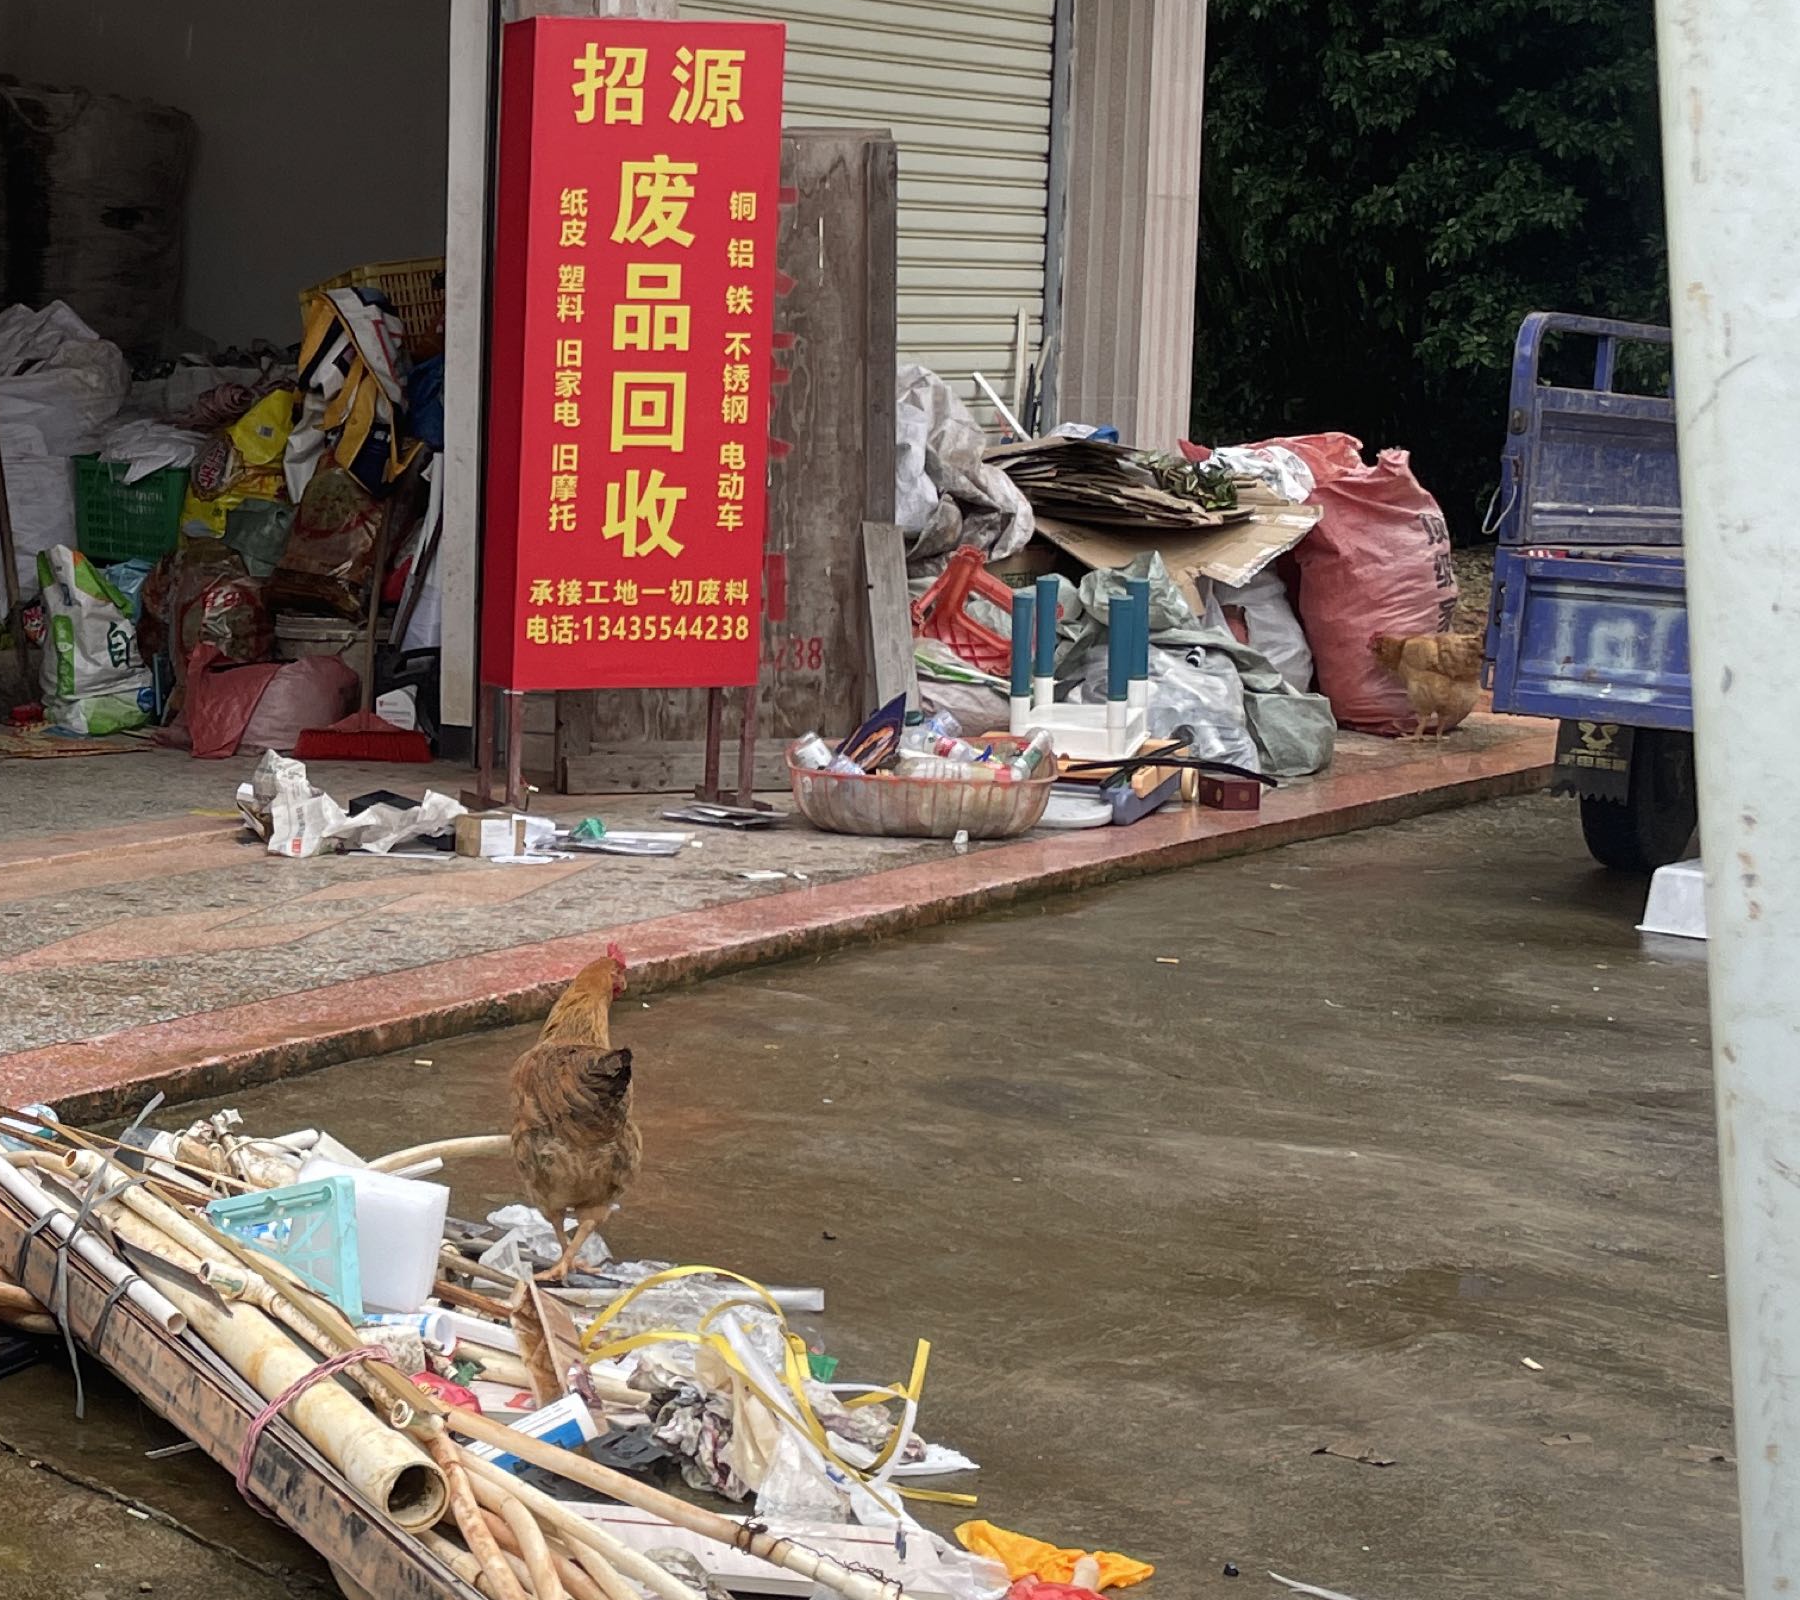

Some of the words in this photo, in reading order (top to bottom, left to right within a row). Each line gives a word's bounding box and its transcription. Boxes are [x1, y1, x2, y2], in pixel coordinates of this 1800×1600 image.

[572, 43, 746, 129] 招源
[559, 188, 589, 248] 纸皮
[729, 191, 757, 221] 铜
[727, 238, 755, 268] 铝
[556, 265, 585, 324] 塑料
[725, 284, 754, 316] 铁
[553, 338, 583, 429] 旧家电
[601, 154, 699, 559] 废品回收
[722, 331, 751, 426] 不锈钢
[548, 443, 579, 533] 旧摩托
[716, 441, 746, 532] 电动车
[529, 578, 750, 607] 承接工地一切废料
[526, 613, 750, 646] 电话:13435544238
